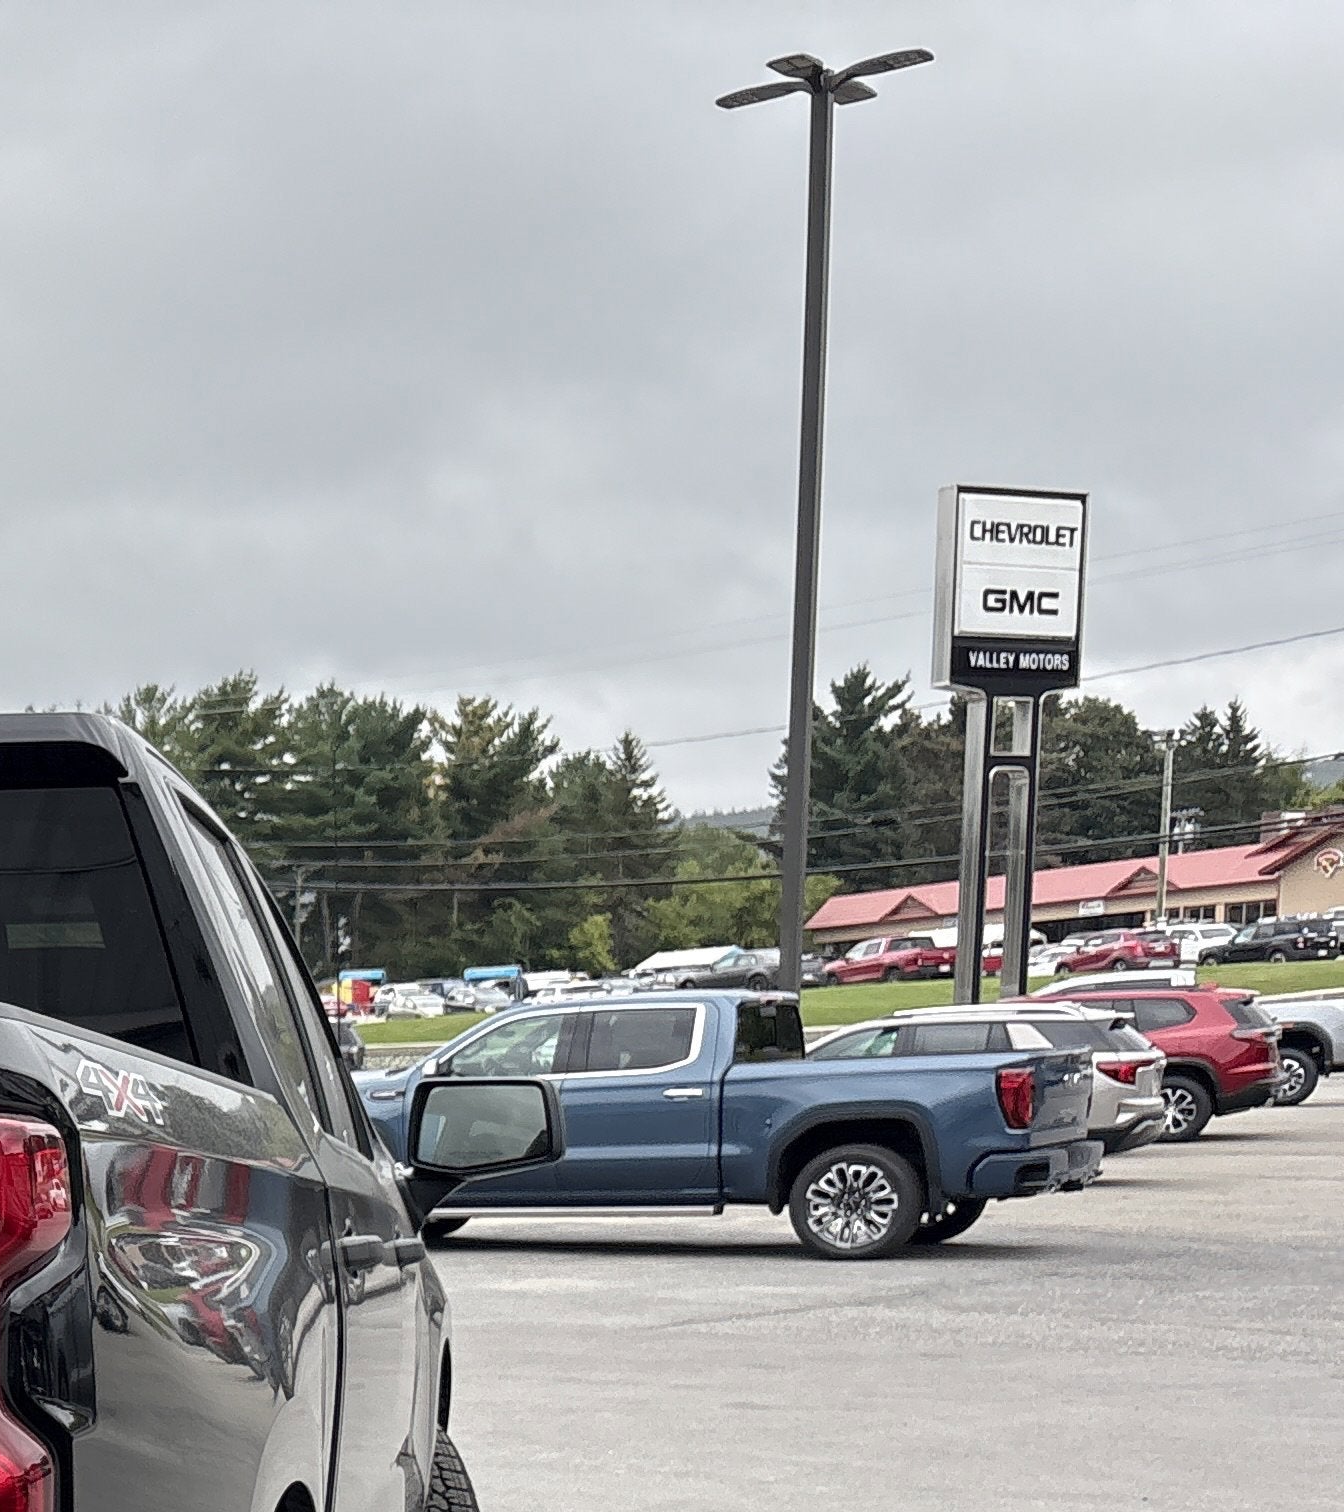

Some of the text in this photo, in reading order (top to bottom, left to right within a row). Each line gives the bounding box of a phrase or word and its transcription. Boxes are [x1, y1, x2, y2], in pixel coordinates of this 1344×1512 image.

[969, 519, 1078, 548] CHEVROLET
[982, 588, 1060, 616] GMC
[968, 650, 1070, 671] VALLEY MOTORS
